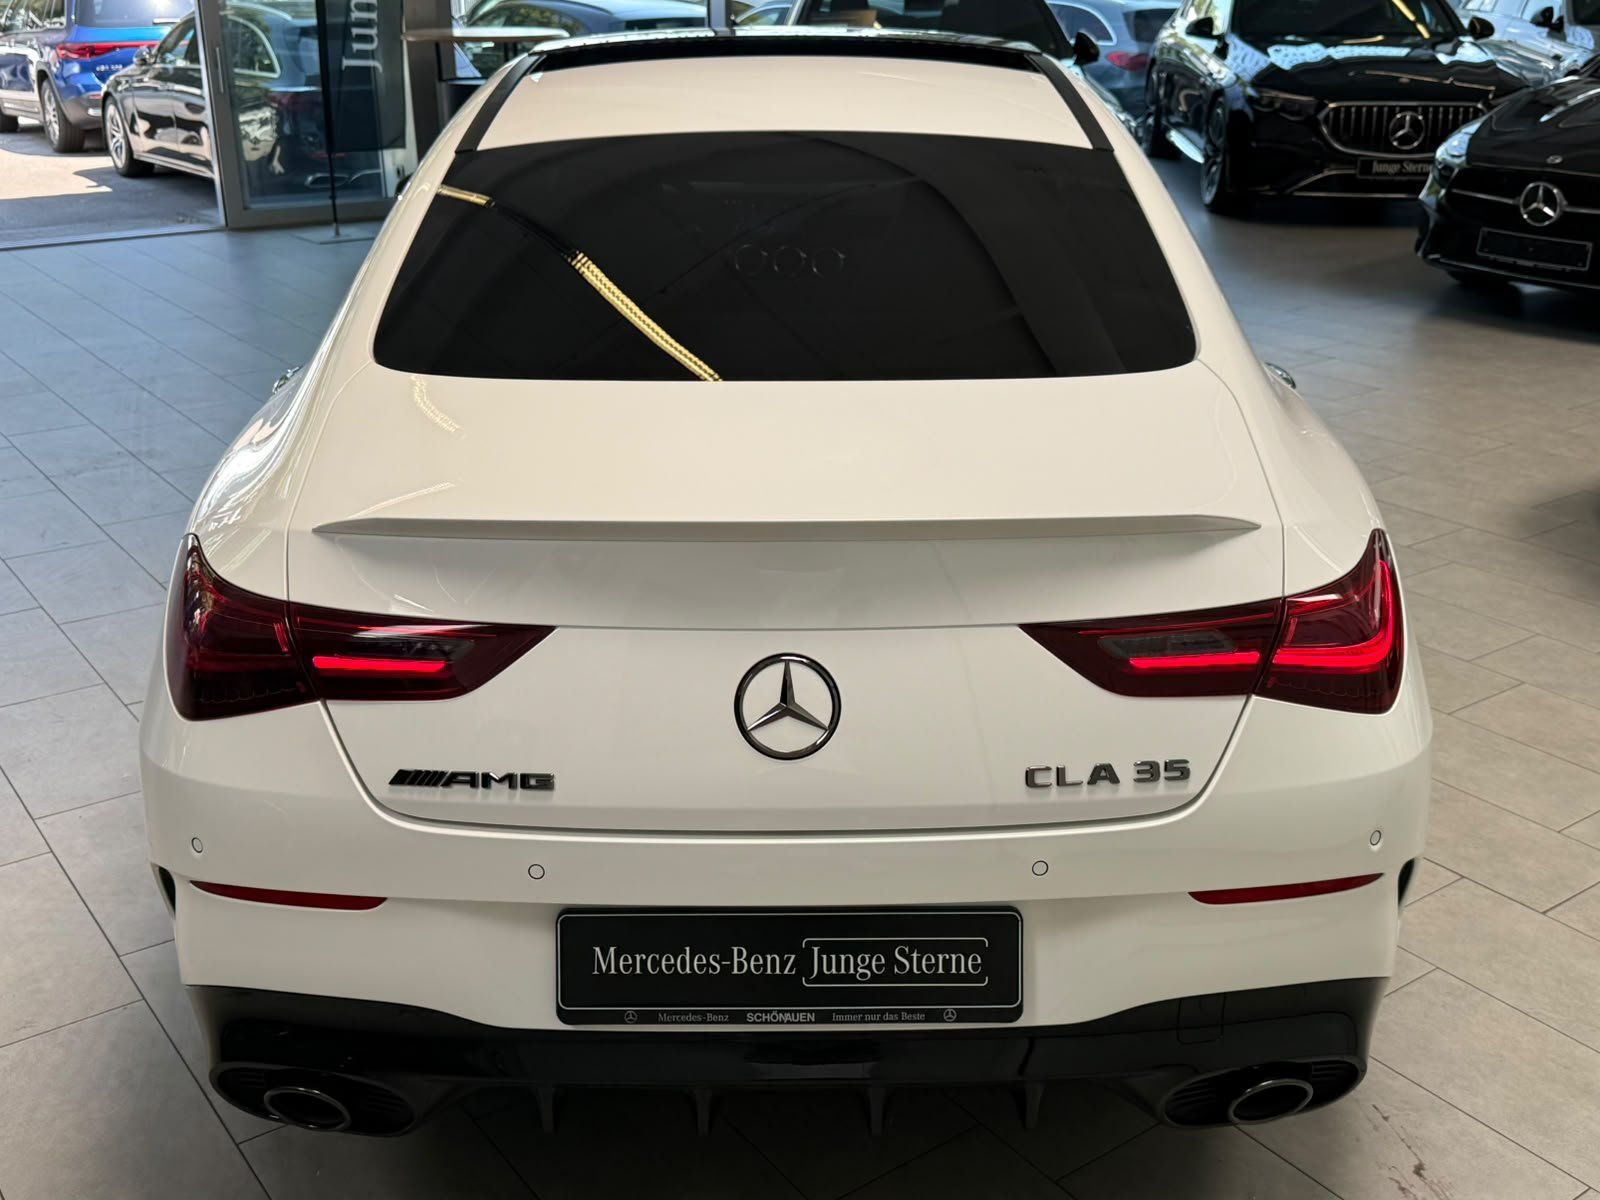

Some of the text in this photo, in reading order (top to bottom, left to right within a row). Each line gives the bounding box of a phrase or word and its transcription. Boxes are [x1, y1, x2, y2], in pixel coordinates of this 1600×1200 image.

[440, 771, 556, 790] AMG
[1025, 759, 1191, 787] CLA 35
[592, 945, 981, 981] Mercedes-Benz Junge Sterne
[659, 1012, 729, 1022] Mercedes-Benz
[832, 1012, 863, 1021] Immer
[866, 1013, 882, 1021] nur
[884, 1011, 898, 1021] das
[901, 1011, 925, 1020] Beste
